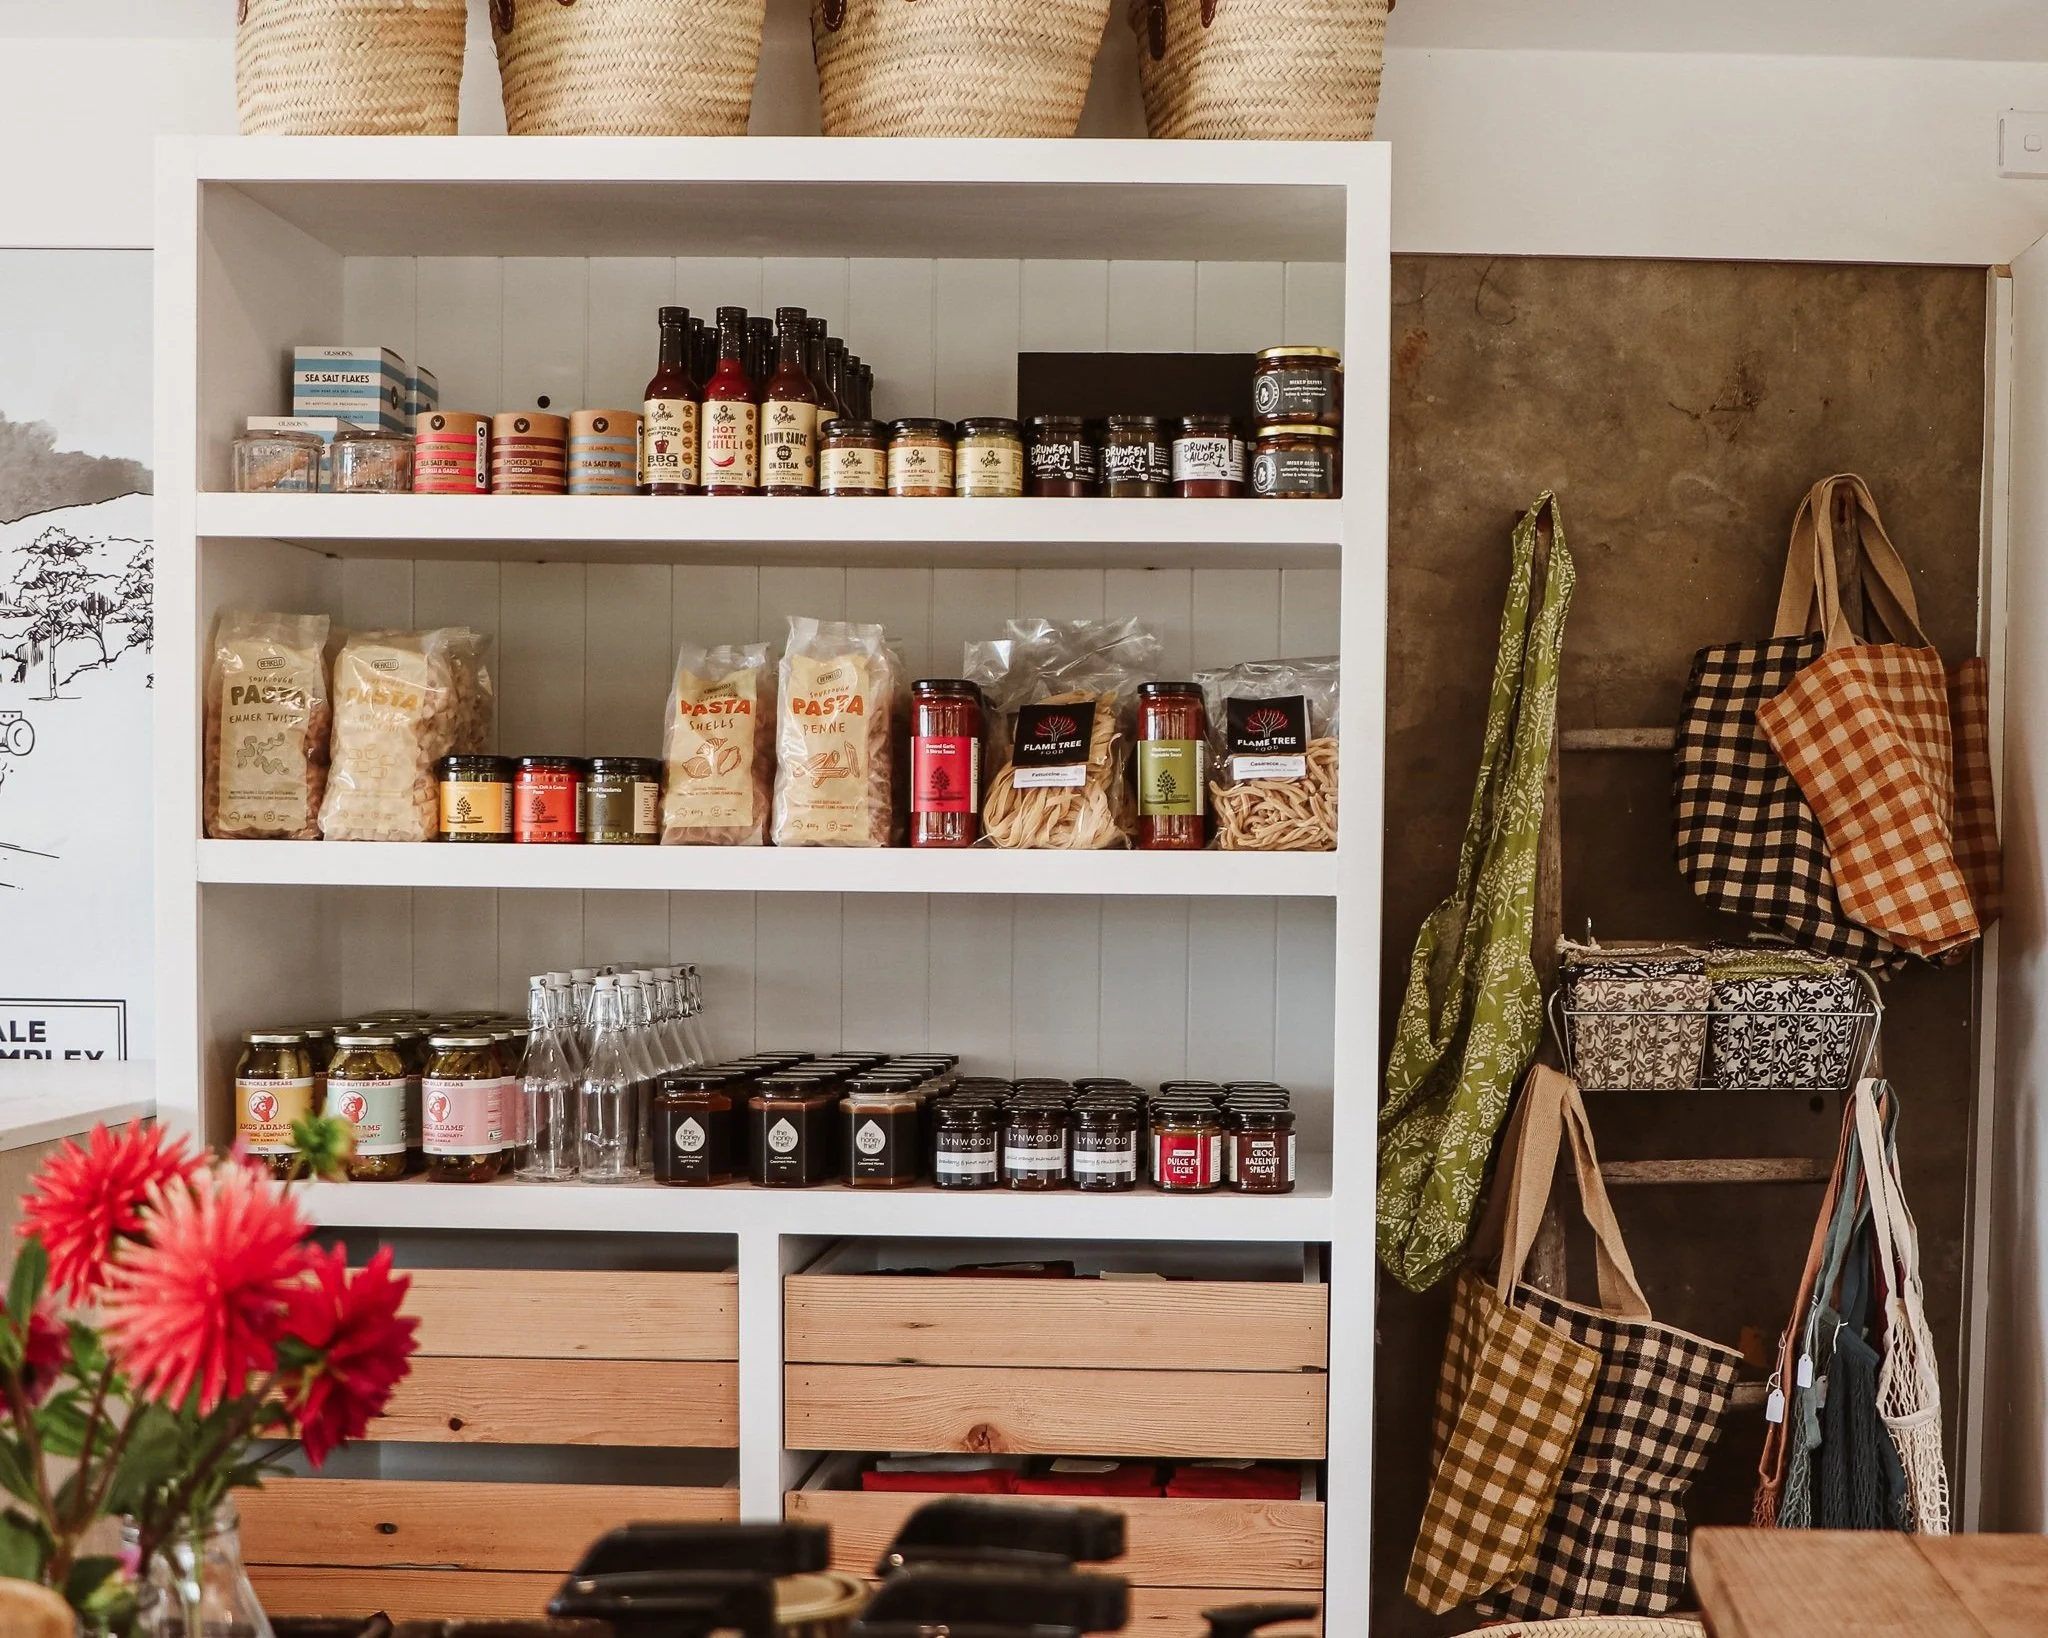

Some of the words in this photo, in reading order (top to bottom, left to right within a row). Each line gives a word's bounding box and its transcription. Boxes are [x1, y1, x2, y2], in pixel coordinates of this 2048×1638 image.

[305, 374, 320, 382] SEA
[322, 374, 339, 382] SALT
[342, 374, 370, 384] FLAKES
[764, 432, 784, 446] BROWN
[786, 432, 808, 446] SAUCE
[707, 440, 743, 450] CHILLI
[1031, 444, 1072, 455] DRUNKEN
[1184, 442, 1226, 452] DRUNKEN
[1106, 446, 1146, 456] DRUNKEN
[648, 454, 678, 462] BBQ
[1031, 454, 1060, 466] SAILOR
[1106, 455, 1136, 468] SAILOR
[1184, 452, 1214, 462] SAILOR
[231, 684, 305, 709] PASTA
[680, 700, 750, 716] PASTA
[792, 695, 864, 716] PASTA
[230, 713, 262, 724] EMMER
[690, 718, 734, 731] SHELLS
[804, 722, 846, 736] PENNE
[1024, 743, 1056, 752] FLAME
[1058, 740, 1082, 748] TREE
[1238, 739, 1270, 747] FLAME
[1272, 736, 1296, 744] TREE
[941, 1138, 992, 1146] LYNWOOD
[1008, 1134, 1058, 1142] LYNWOOD
[1078, 1137, 1128, 1146] LYNWOOD
[1168, 1158, 1188, 1166] DULCE
[1190, 1158, 1200, 1166] DE
